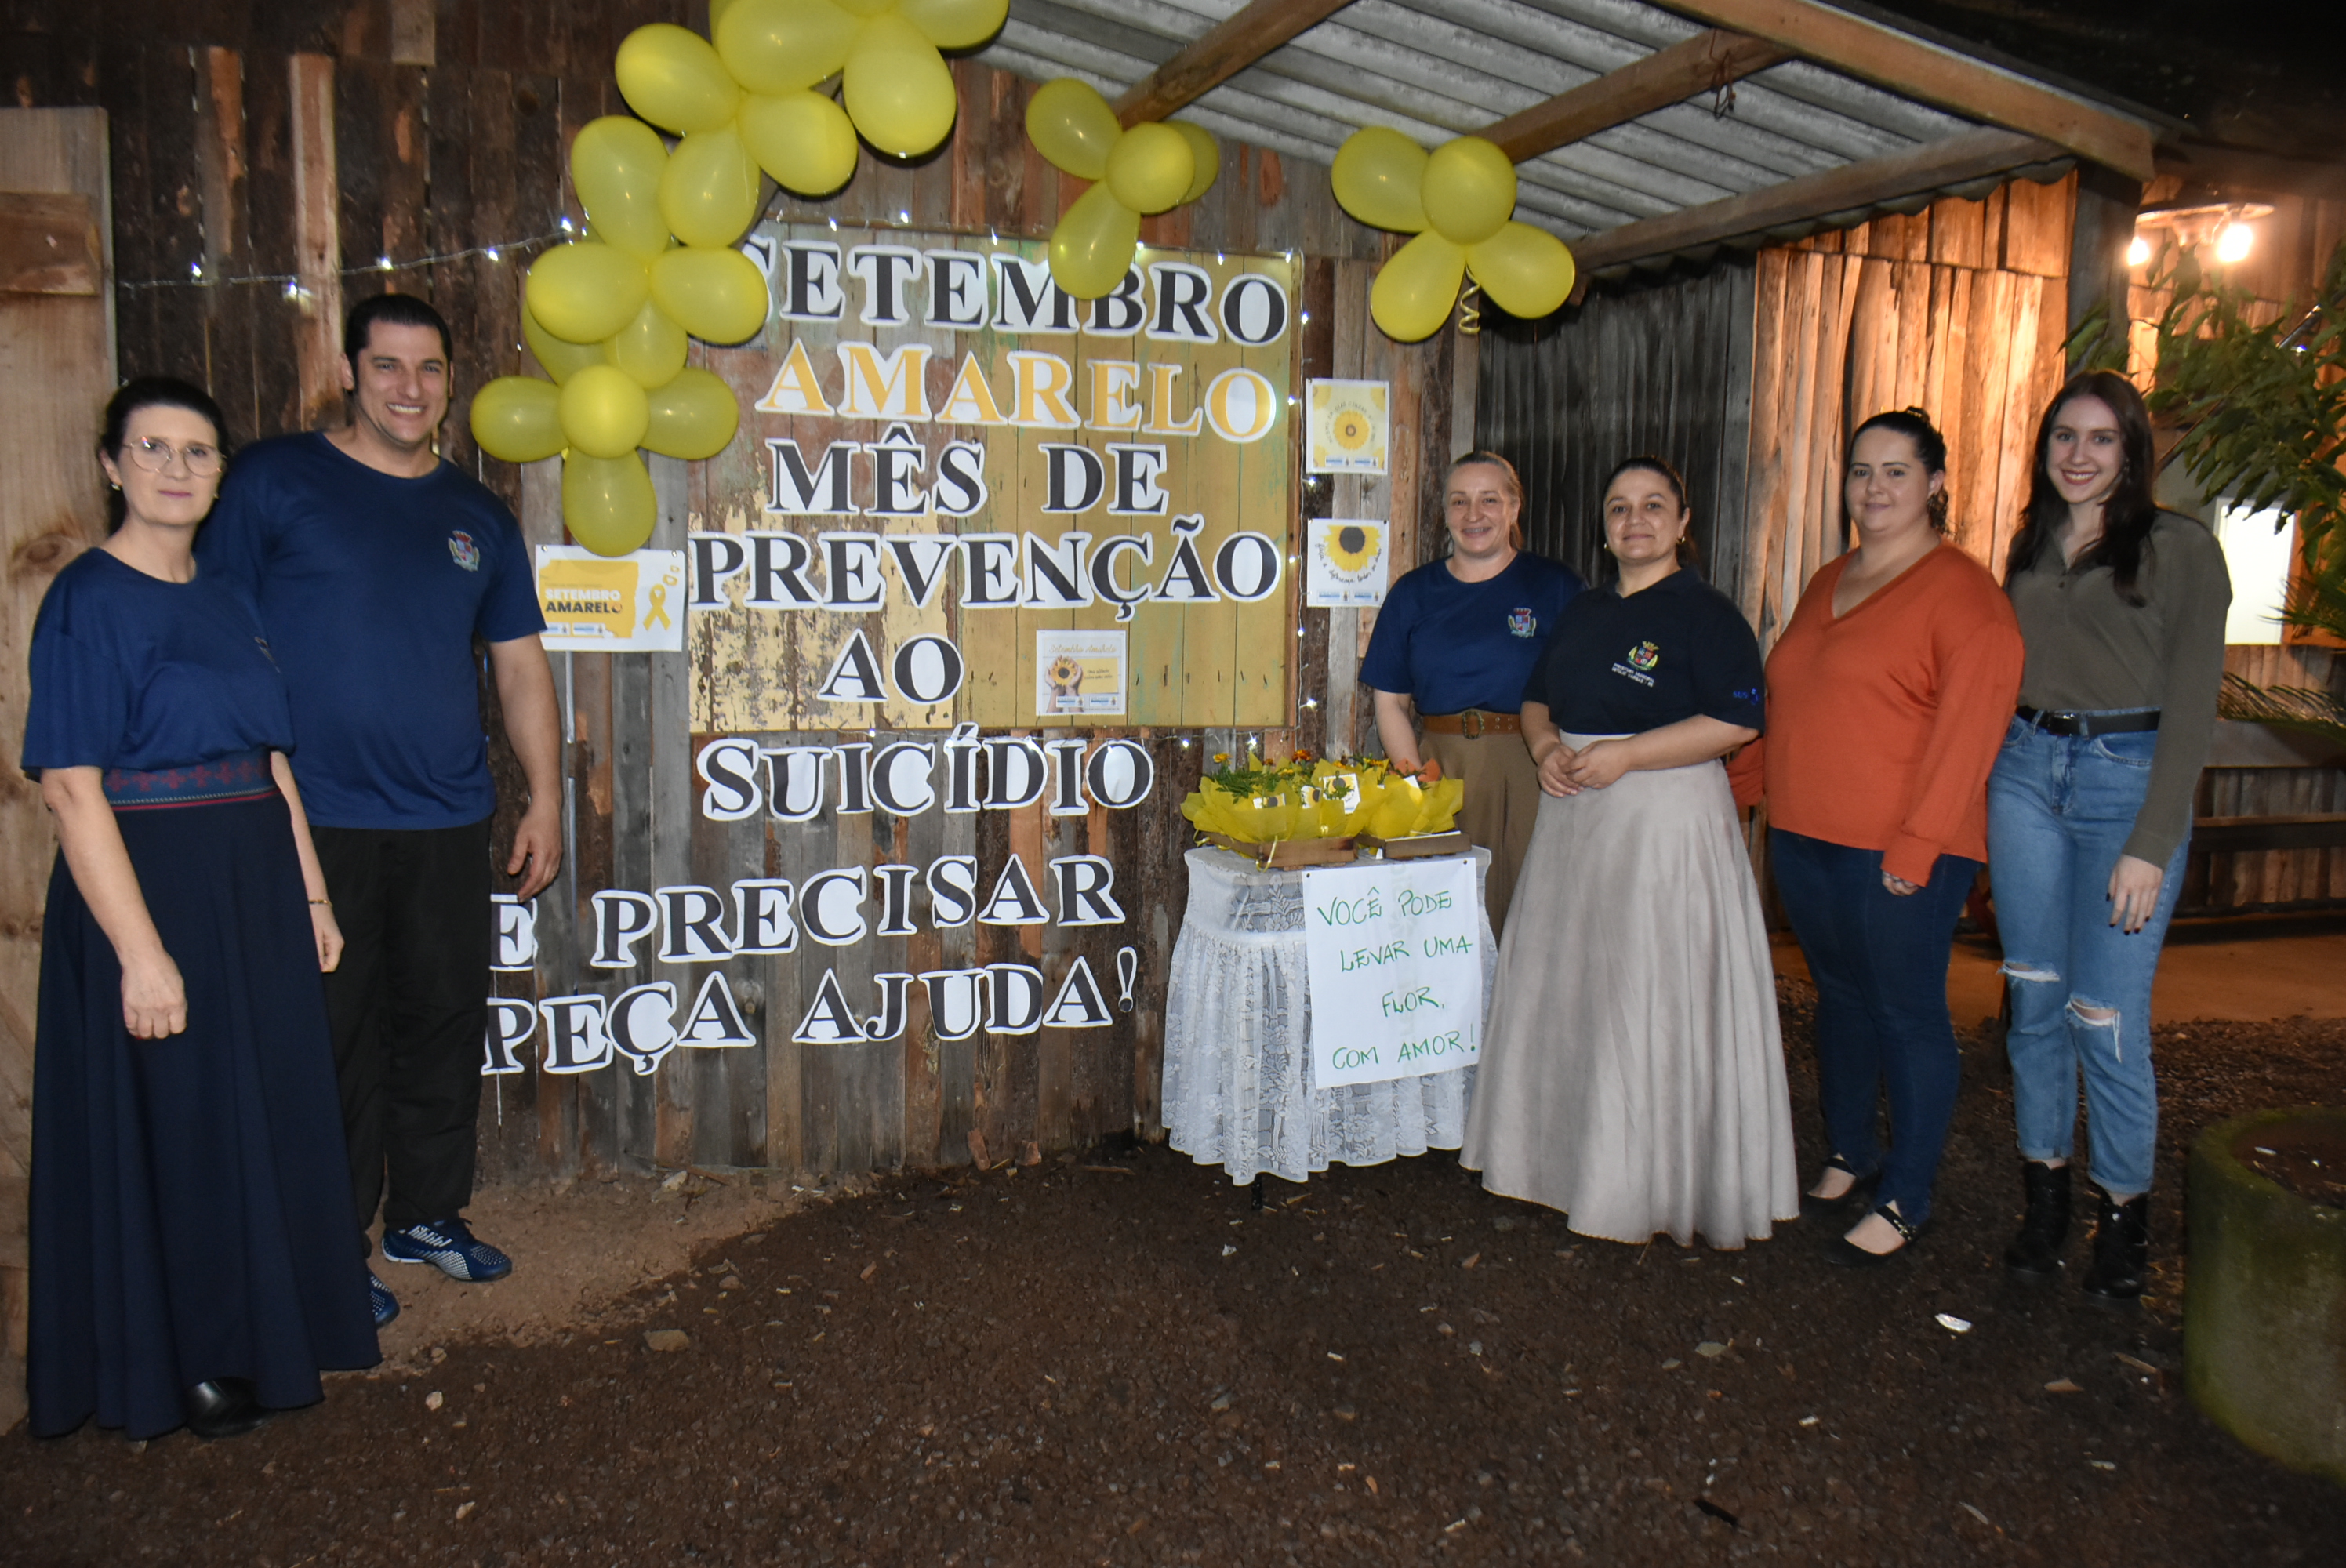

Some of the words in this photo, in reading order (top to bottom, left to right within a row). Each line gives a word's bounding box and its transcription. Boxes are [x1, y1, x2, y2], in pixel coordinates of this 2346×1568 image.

[745, 239, 1286, 344] ETEMBRO
[761, 342, 1273, 439] AMARELO
[767, 426, 985, 515] MÊS
[1041, 444, 1168, 514] DE
[545, 588, 621, 601] SETEMBRO
[545, 601, 623, 614] AMARELO
[692, 517, 1278, 620] PREVENÇÃO
[820, 631, 963, 702] AO
[702, 723, 1152, 818] SUICÍDIO
[593, 857, 1124, 966] PRECISAR
[1317, 887, 1382, 926] VOCÊ
[1397, 889, 1452, 917] PODE
[1339, 940, 1410, 972] LEVAR
[1423, 935, 1473, 958] UMA
[483, 971, 754, 1074] PEÇA
[794, 947, 1137, 1042] AJUDA!
[1332, 1046, 1379, 1070] COM
[1397, 1022, 1476, 1063] AMOR!
